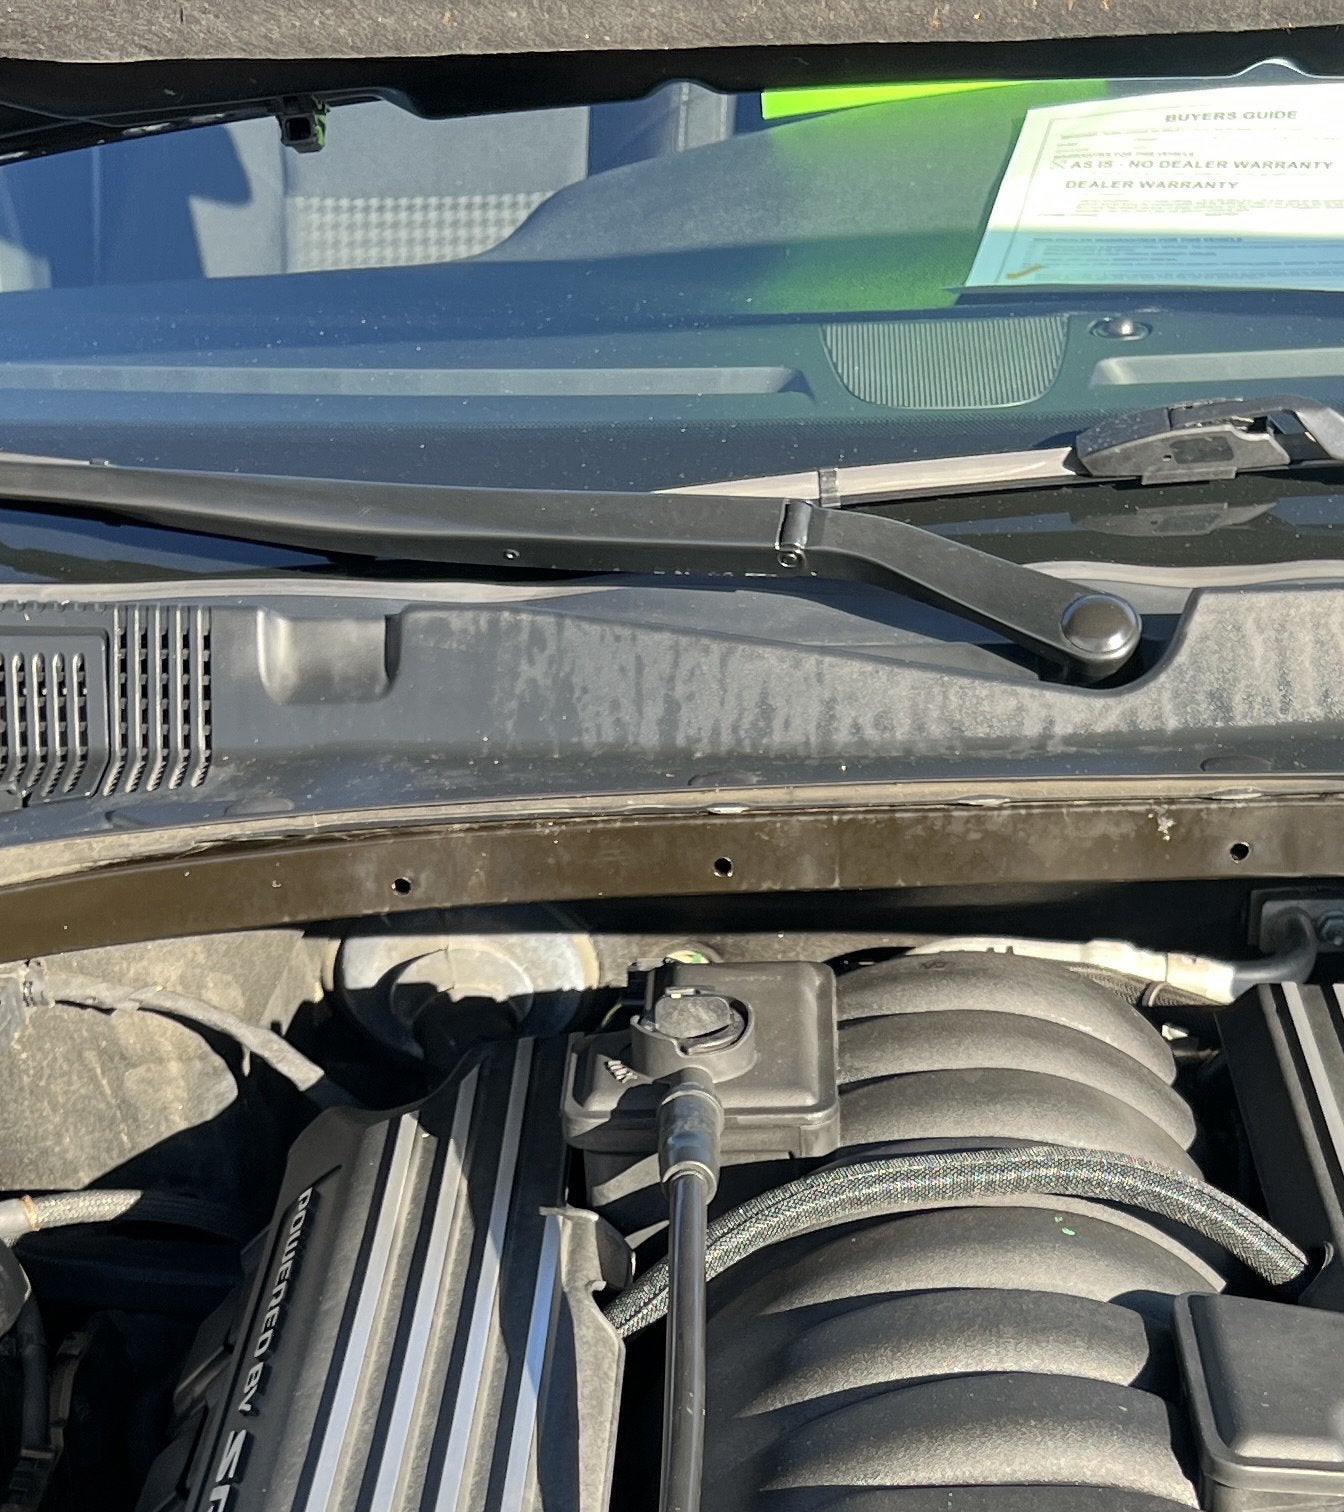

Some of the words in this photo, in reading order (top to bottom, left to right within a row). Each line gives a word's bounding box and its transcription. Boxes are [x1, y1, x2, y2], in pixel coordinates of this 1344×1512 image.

[1165, 111, 1238, 123] BUYERS
[1242, 110, 1299, 120] GUIDE
[1070, 160, 1093, 170] AS
[1098, 160, 1114, 169] IS
[1129, 160, 1154, 169] NO
[1159, 160, 1228, 169] DEALER
[1233, 160, 1334, 170] WARRANTY
[1065, 180, 1134, 190] DEALER
[1139, 180, 1240, 190] WARRANTY
[254, 1187, 314, 1359] POWERED
[236, 1361, 265, 1413] BY
